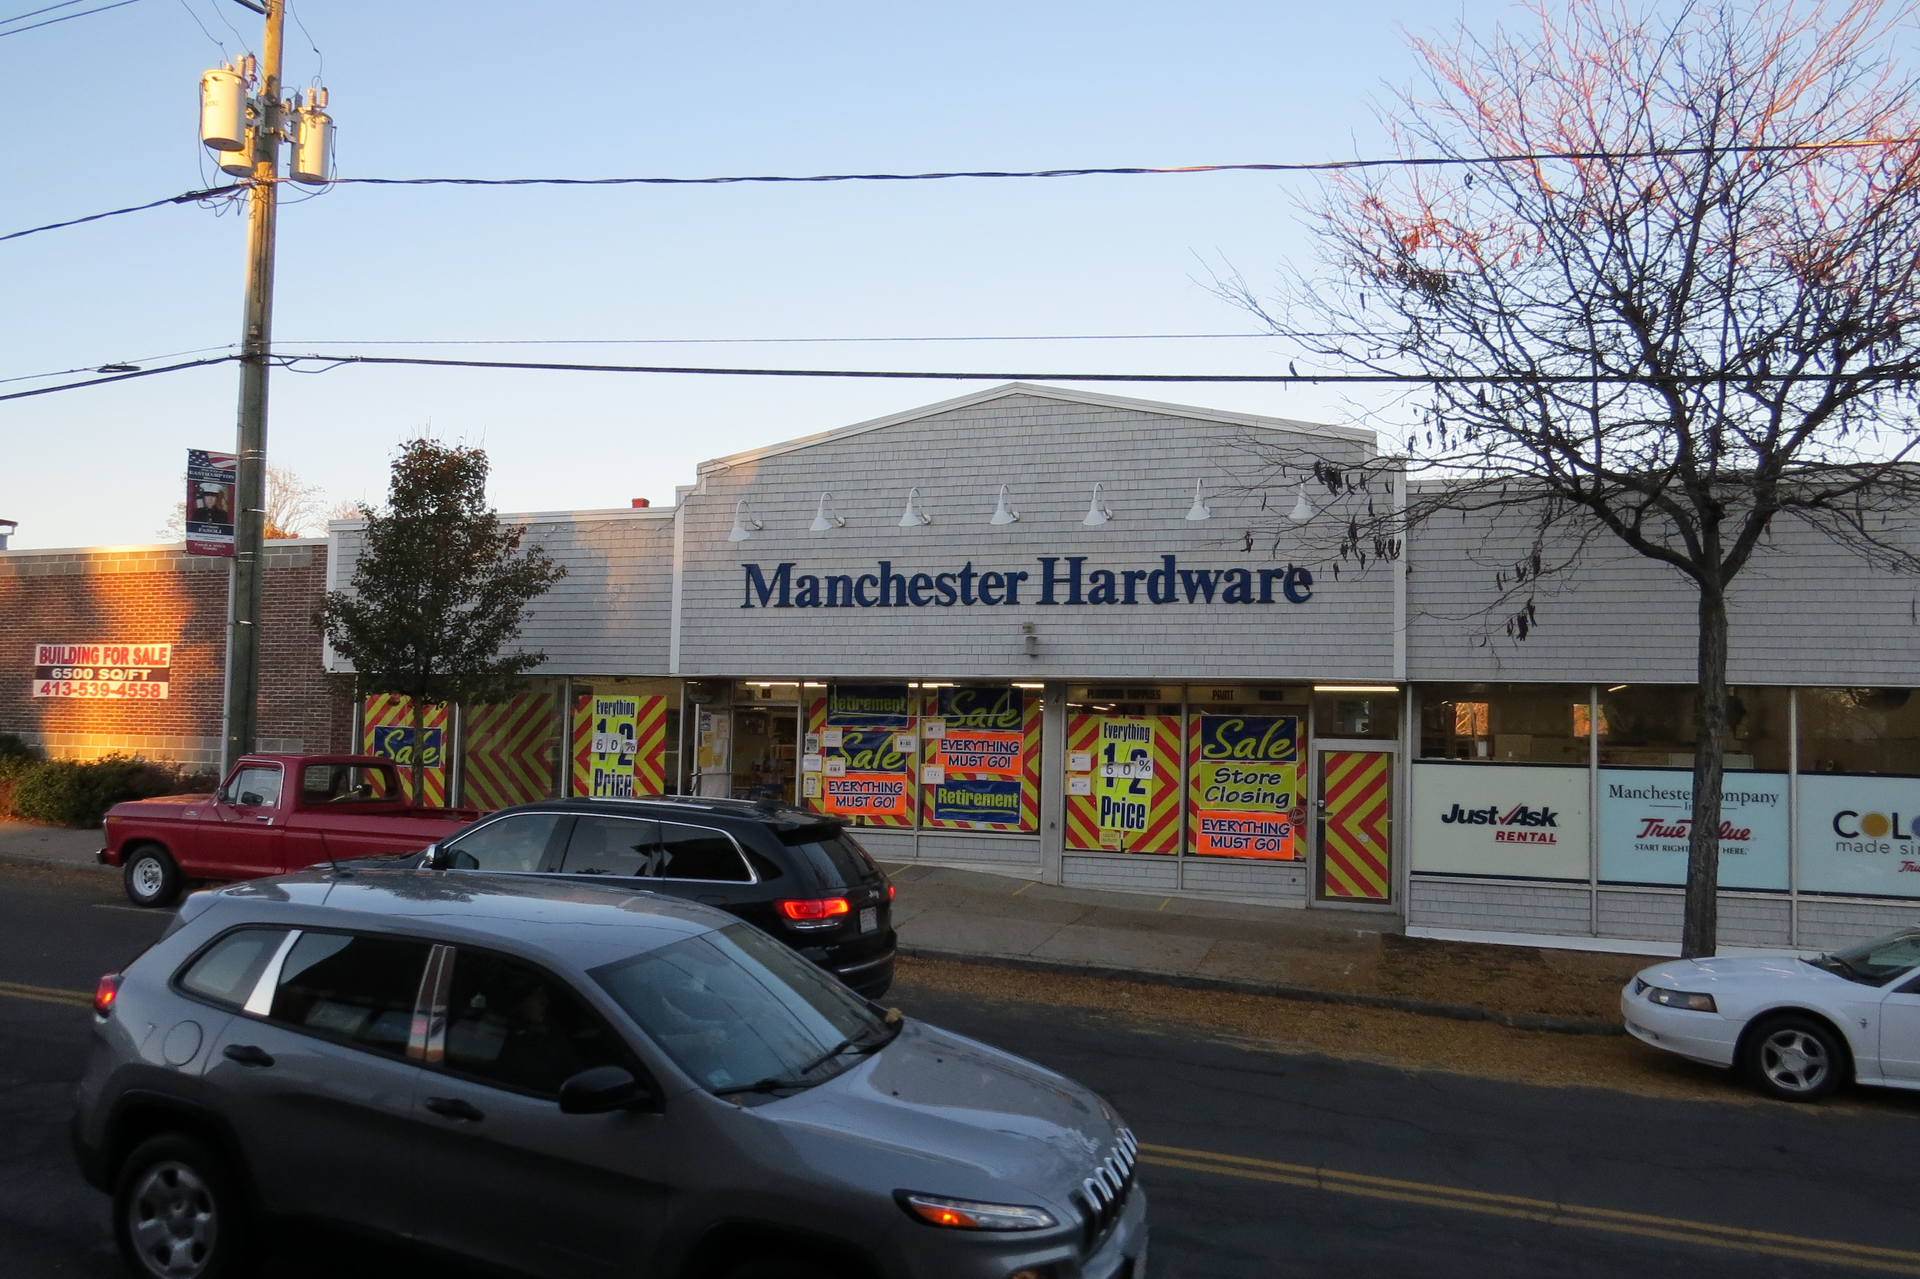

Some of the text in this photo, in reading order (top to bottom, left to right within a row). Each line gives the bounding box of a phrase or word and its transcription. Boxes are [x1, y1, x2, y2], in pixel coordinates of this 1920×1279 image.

[189, 470, 235, 479] EASTHAMPTON
[740, 554, 1314, 609] Manchester Hardware
[39, 646, 168, 666] BUILDING FOR SALE
[52, 667, 152, 681] 6500 SQ/FT
[40, 681, 161, 698] 413-539-4558
[1127, 689, 1161, 700] SUPPLIES
[1212, 689, 1234, 701] PAINT
[596, 699, 635, 718] Everything
[829, 695, 906, 712] Retirement
[940, 690, 1022, 728] Sale
[1103, 721, 1150, 744] Everything
[1203, 719, 1295, 759] Sale
[829, 732, 906, 769] Sale
[940, 739, 1020, 753] EVERYTHING
[948, 755, 1011, 768] MUST GO!
[594, 768, 632, 797] Price
[1214, 767, 1282, 785] Store
[828, 780, 903, 793] EVERYTHING
[836, 796, 895, 808] MUST GO!
[938, 788, 1019, 808] Retirement
[1204, 785, 1290, 809] Closing
[1100, 795, 1146, 830] Price
[1441, 803, 1558, 828] Just Ask
[1202, 818, 1290, 835] EVERYTHING
[1636, 817, 1686, 839] True
[1210, 836, 1281, 851] MUST GO!
[1495, 830, 1557, 843] RENTAL
[1634, 843, 1660, 852] START
[1661, 844, 1690, 853] RIGHT
[1835, 840, 1890, 854] made
